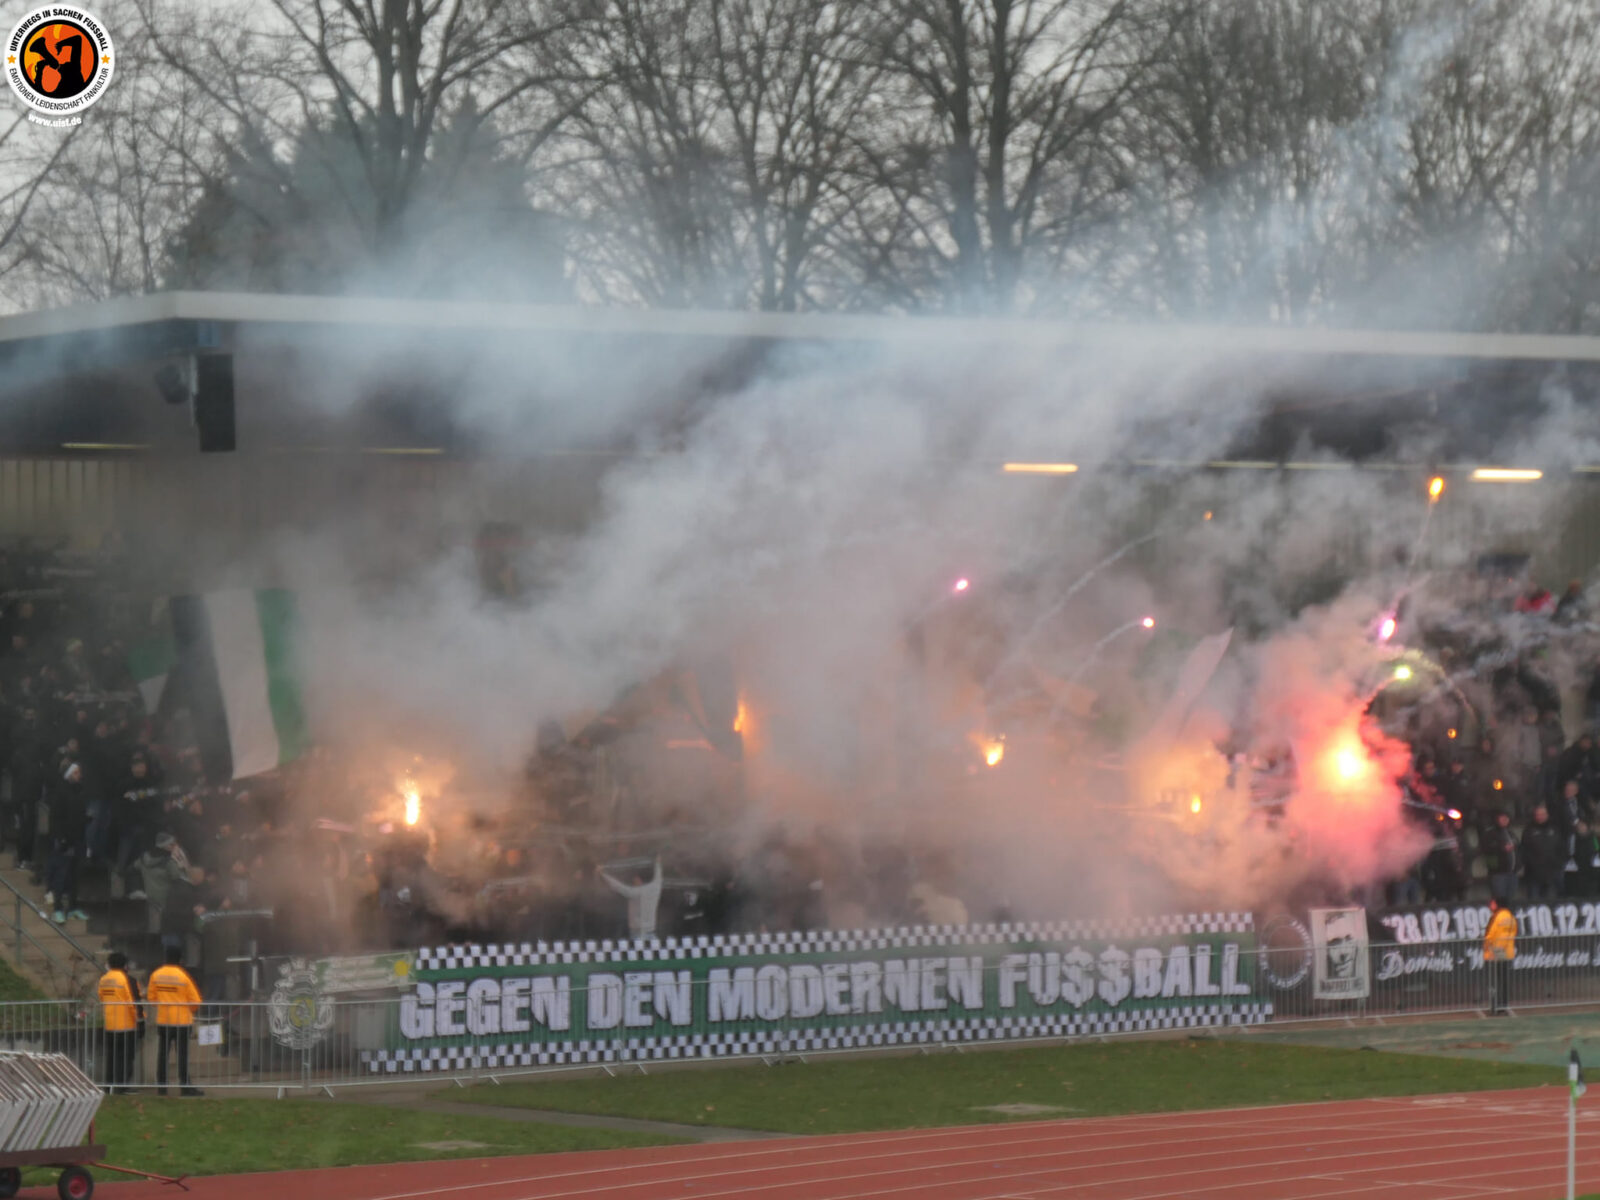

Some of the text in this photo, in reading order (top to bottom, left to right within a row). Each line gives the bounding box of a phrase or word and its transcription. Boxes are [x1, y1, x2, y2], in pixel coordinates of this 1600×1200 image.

[399, 974, 570, 1041] GEGEN
[587, 970, 692, 1031] DEN
[707, 955, 984, 1023] MODERNEN
[999, 943, 1251, 1009] FU$$BALL
[1377, 946, 1454, 981] Dominik
[1513, 945, 1565, 970] enken
